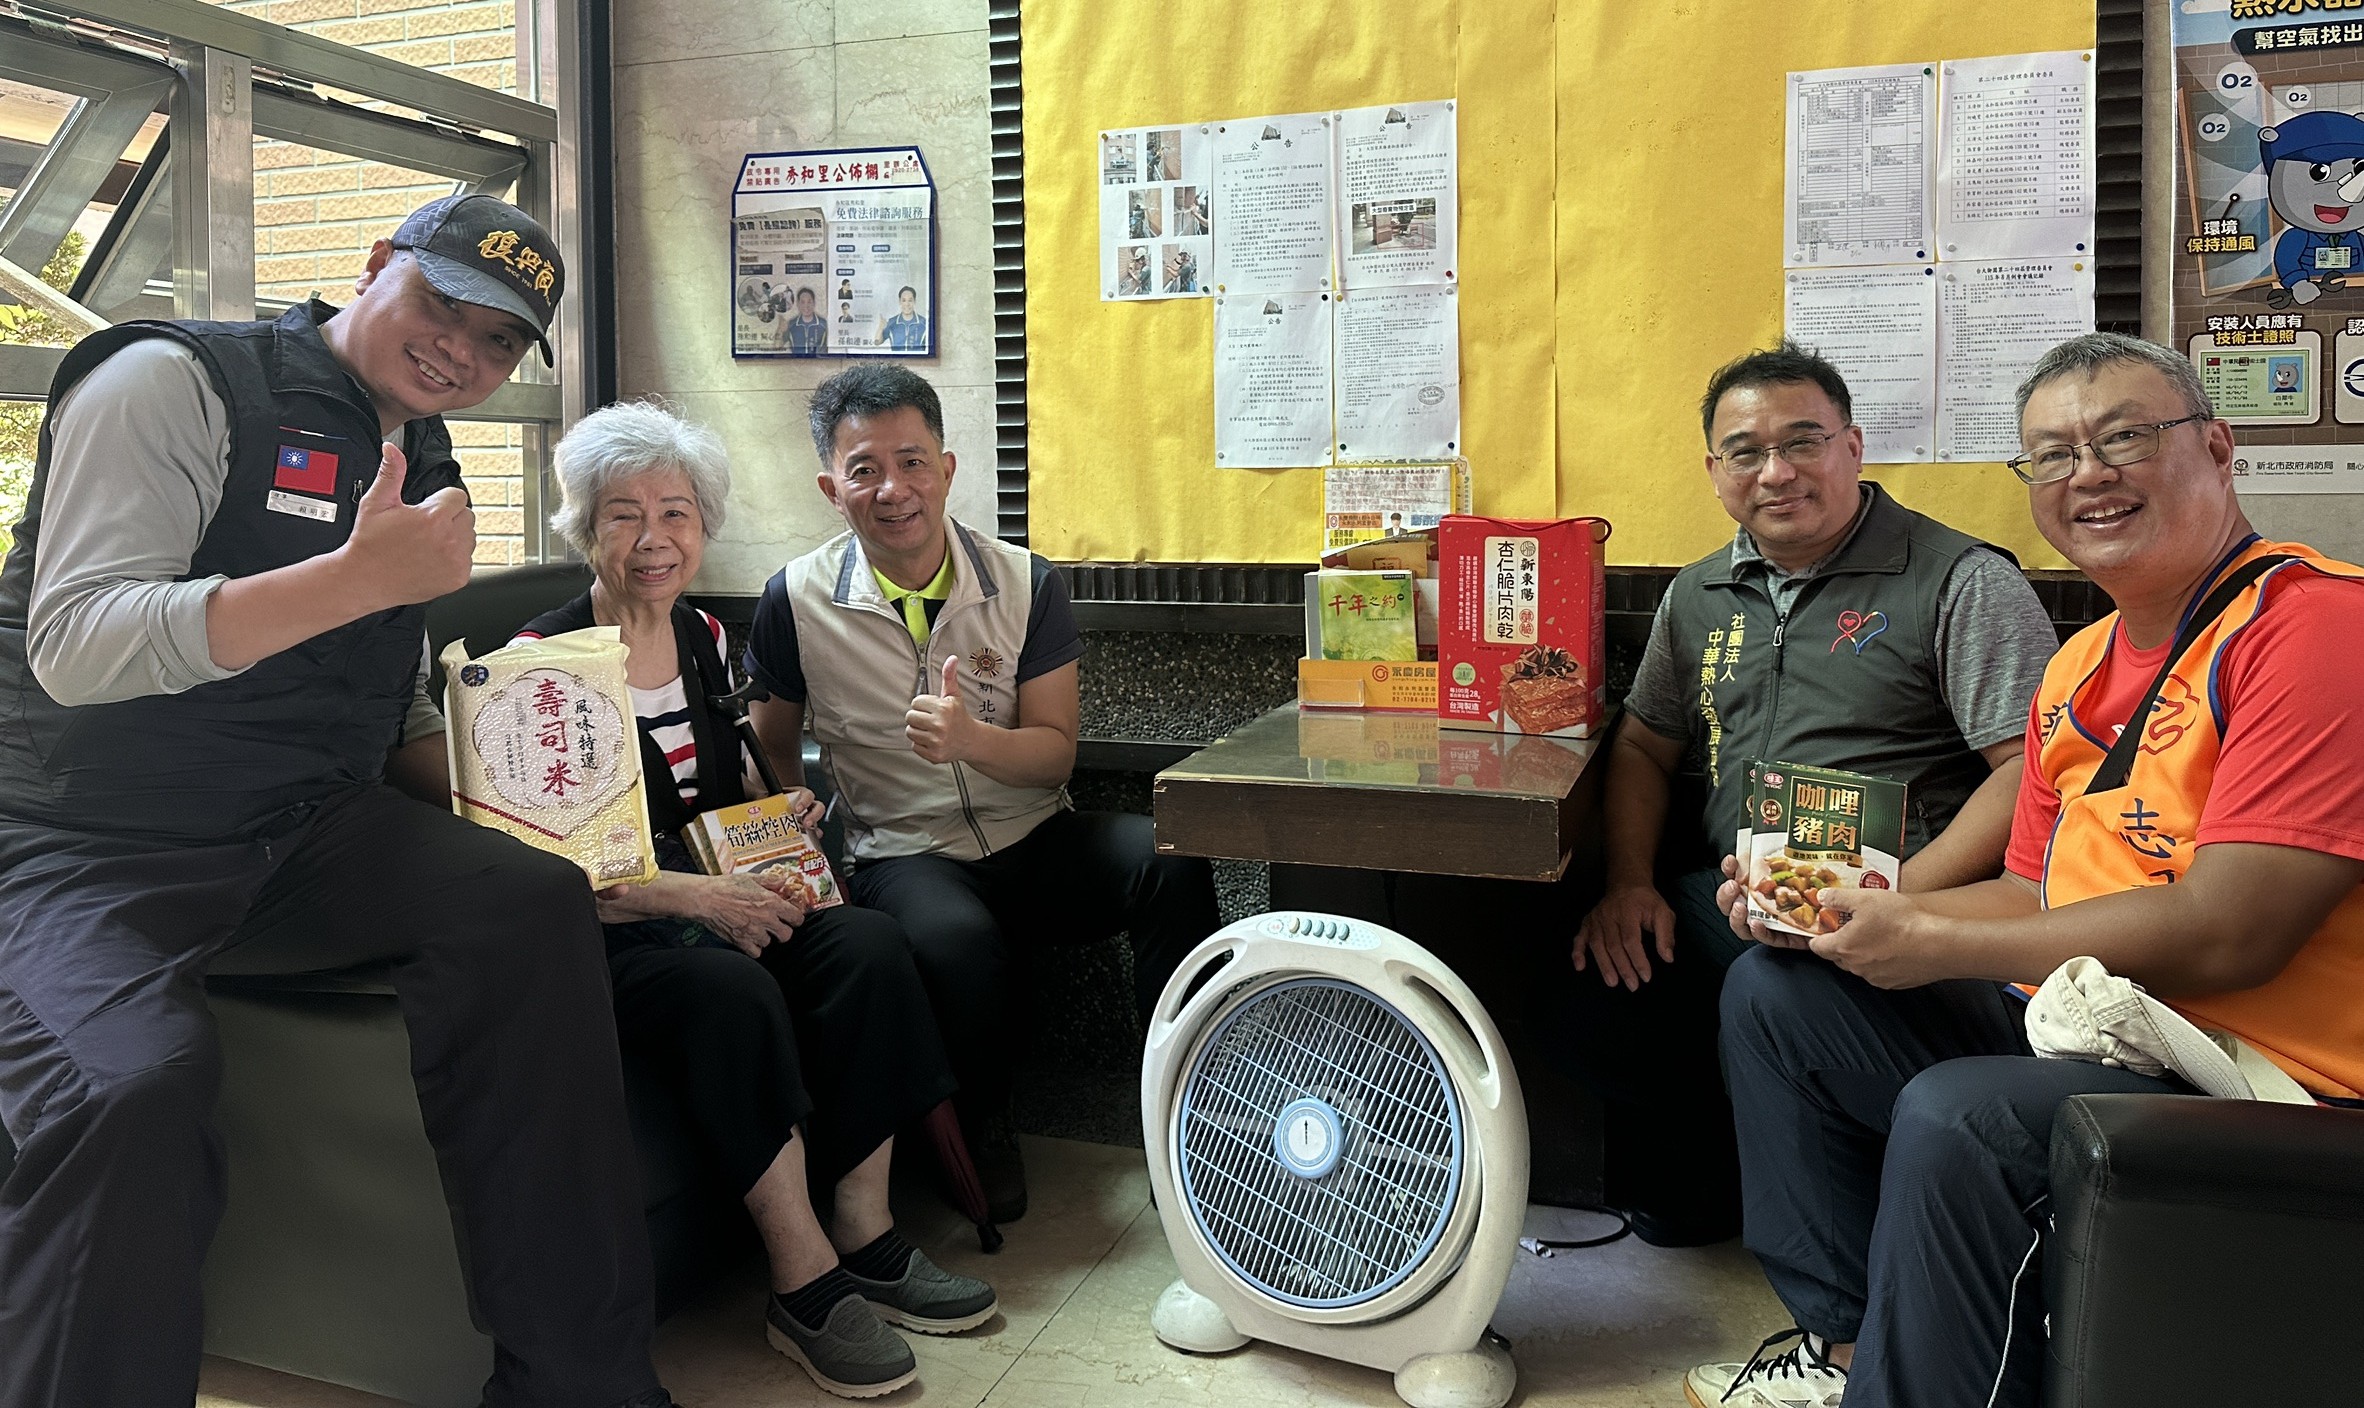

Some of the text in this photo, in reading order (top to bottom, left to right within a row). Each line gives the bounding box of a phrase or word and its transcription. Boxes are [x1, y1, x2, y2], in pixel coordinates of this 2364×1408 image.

[2254, 24, 2363, 50] 幫空氣找出
[746, 167, 780, 176] 政令專用
[746, 177, 780, 186] 禁貼廣告
[786, 163, 879, 186] 秀和里公佈欄
[836, 207, 923, 220] 免費法律諮詢服務
[2204, 220, 2238, 236] 環境
[2186, 236, 2256, 252] 保持通風
[2208, 314, 2302, 331] 安裝人員應有
[2216, 330, 2294, 345] 技術士證照
[2256, 461, 2334, 470] 新北市政府消防局
[1496, 541, 1514, 638] 杏仁脆片肉乾
[1520, 558, 1536, 601] 新東陽
[1328, 594, 1396, 616] 千年之約
[1720, 612, 1746, 682] 社團法人
[1392, 666, 1436, 677] 永慶房屋
[1450, 702, 1479, 710] 台灣製造
[532, 678, 581, 796] 壽司米
[575, 699, 598, 770] 風味特選
[1796, 784, 1860, 817] 咖哩
[1793, 816, 1857, 850] 豬肉
[2120, 798, 2177, 884] 志
